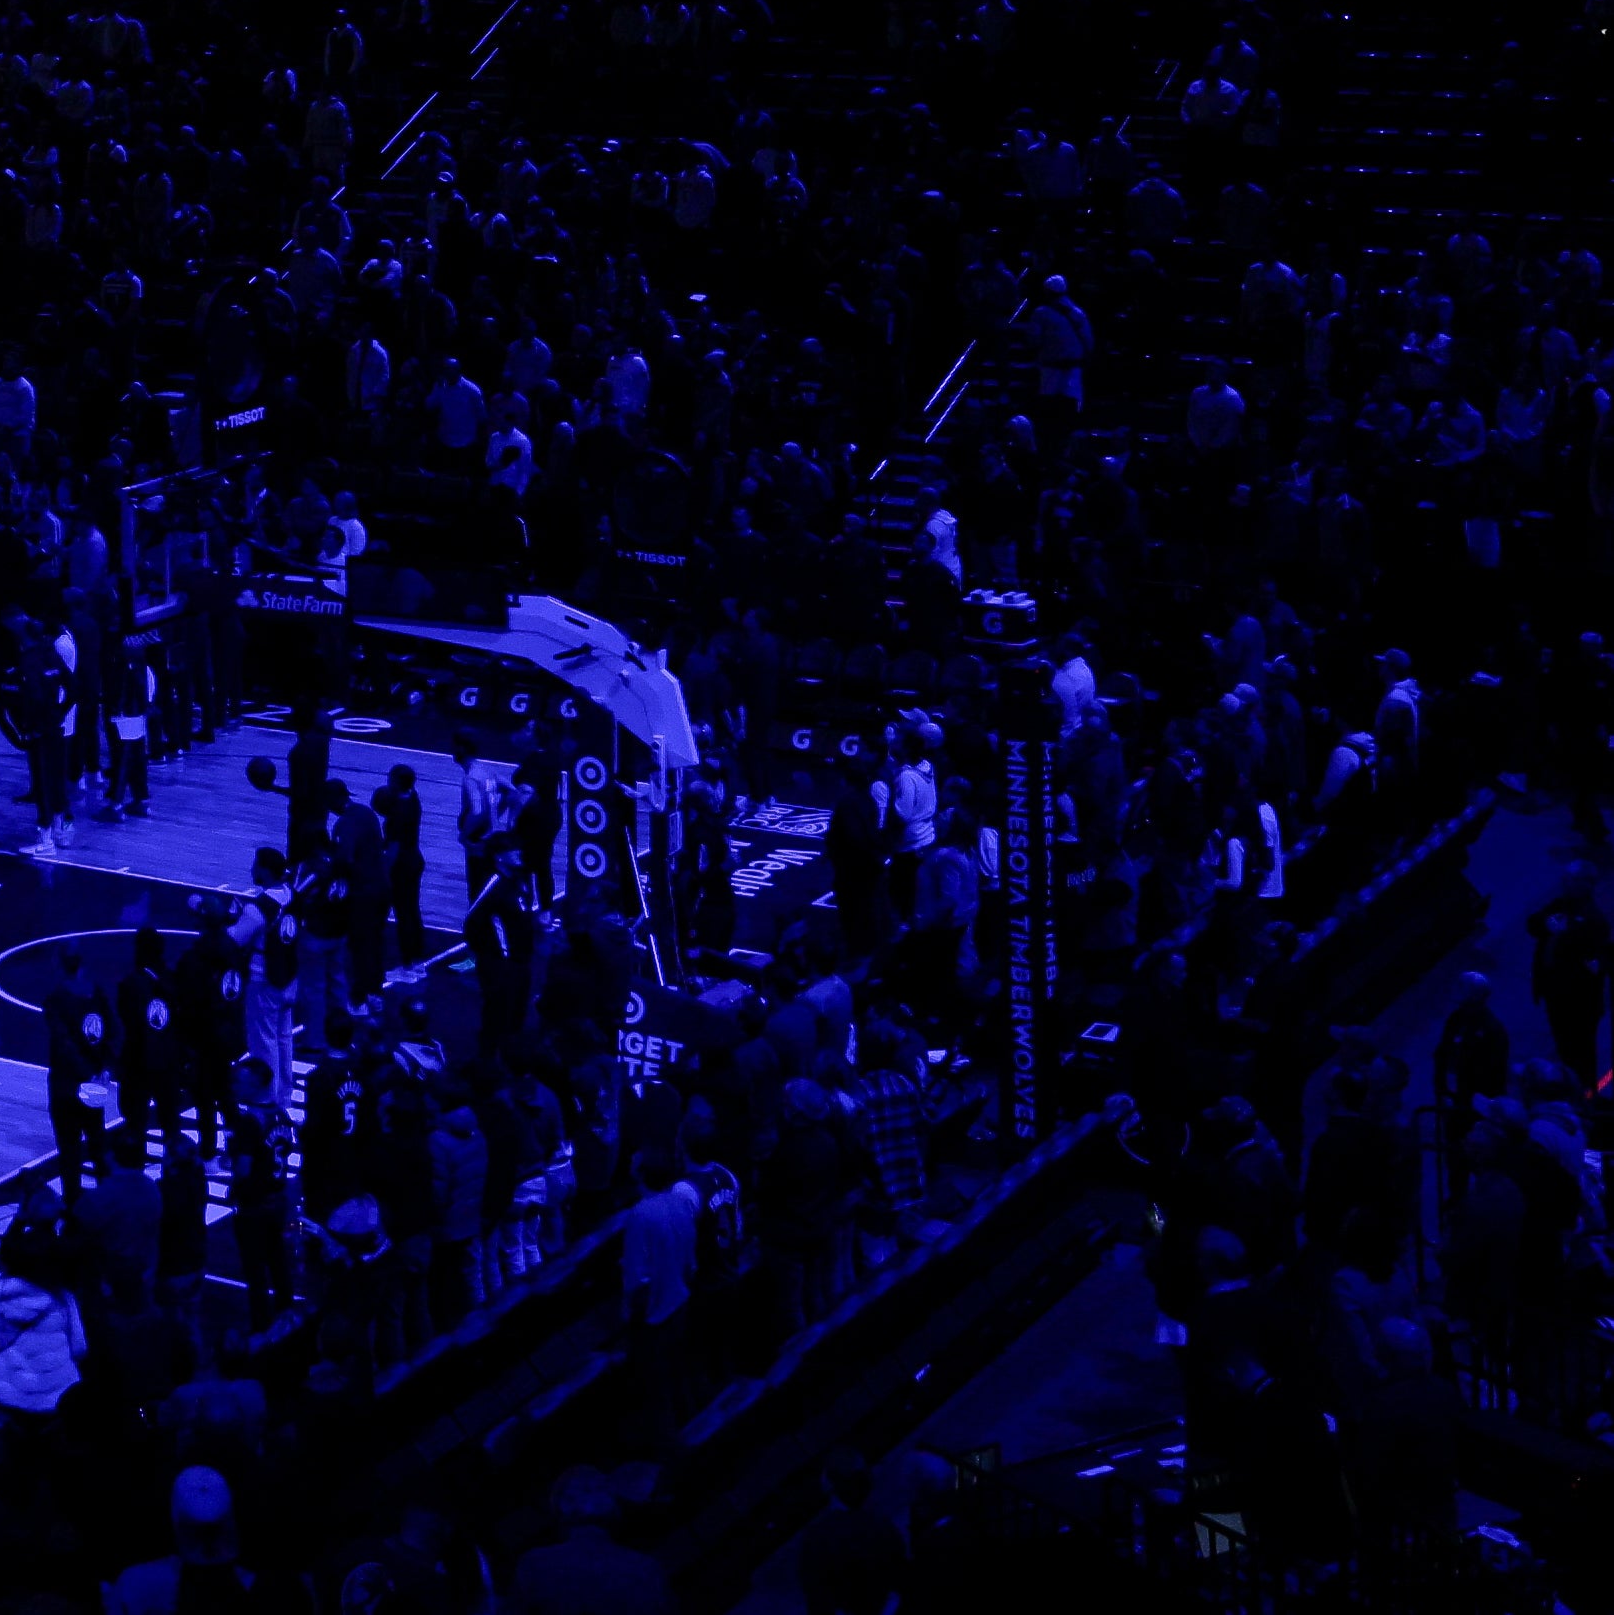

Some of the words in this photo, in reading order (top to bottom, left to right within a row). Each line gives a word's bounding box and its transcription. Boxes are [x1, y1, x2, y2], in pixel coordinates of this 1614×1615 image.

[228, 406, 267, 429] TISSOT
[634, 550, 688, 567] TISSOT
[458, 686, 480, 707] G
[507, 692, 531, 714] G
[790, 728, 815, 752] G
[1004, 739, 1032, 907] MINNESOTA
[1007, 914, 1038, 1139] TIMBERWOLVES
[617, 1029, 685, 1064] GET
